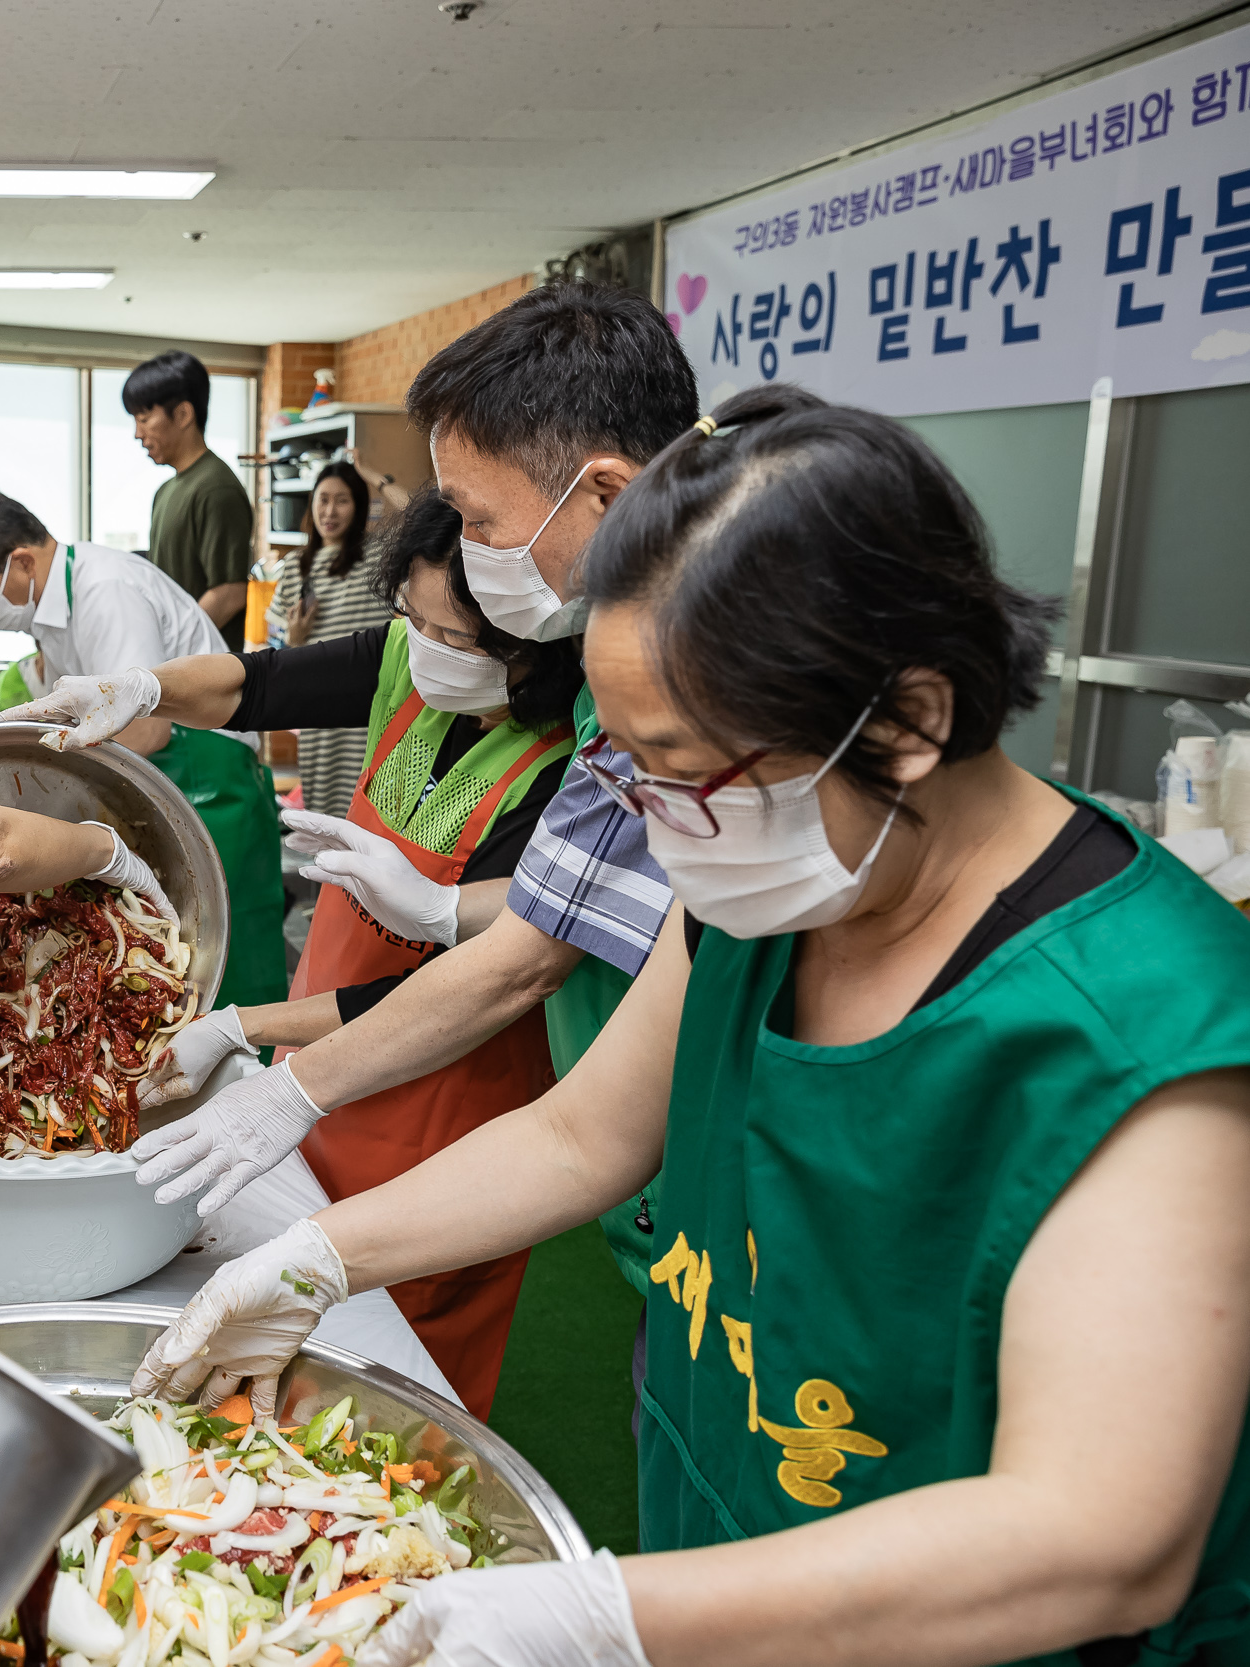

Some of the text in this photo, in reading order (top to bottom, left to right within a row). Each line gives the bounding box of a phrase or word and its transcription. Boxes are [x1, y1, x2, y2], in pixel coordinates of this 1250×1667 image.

[733, 208, 800, 258] 구의3동
[1192, 62, 1250, 128] 함
[711, 270, 837, 381] 사랑의
[869, 218, 1062, 362] 밑반찬
